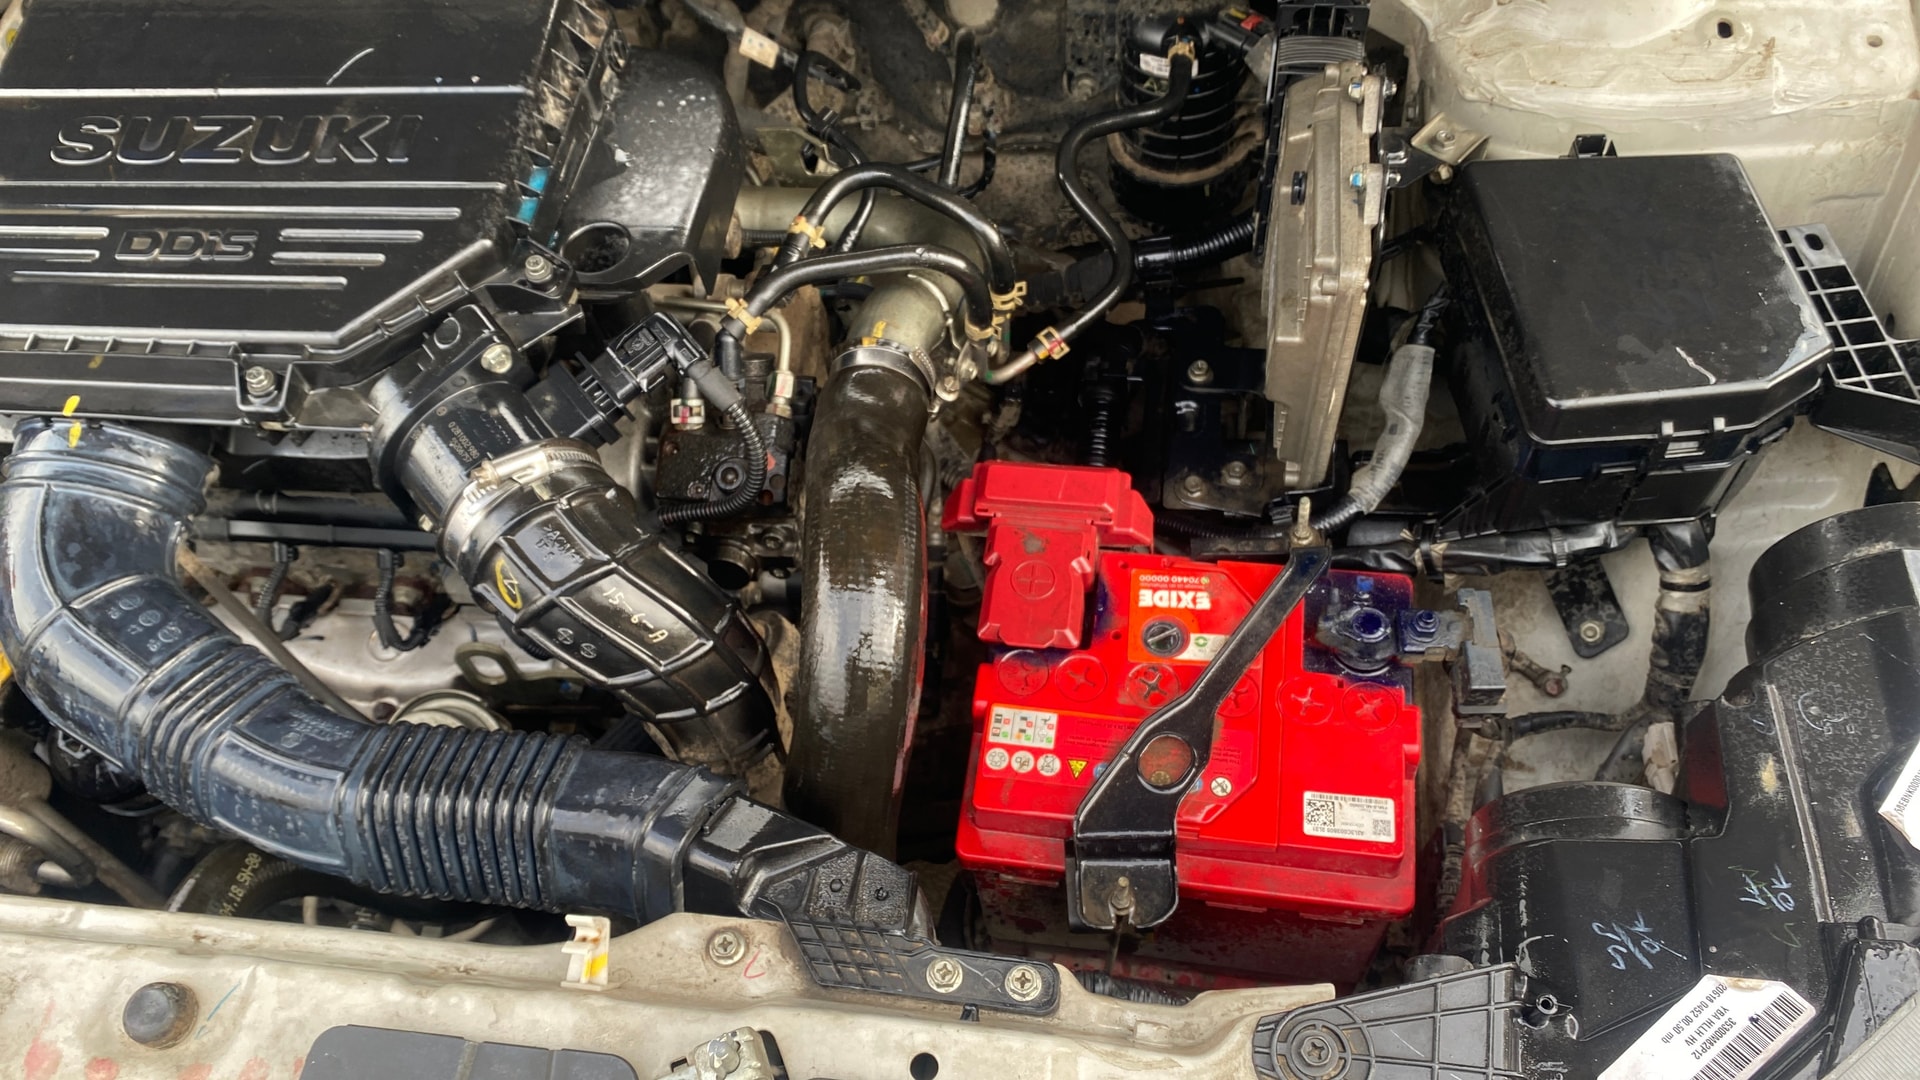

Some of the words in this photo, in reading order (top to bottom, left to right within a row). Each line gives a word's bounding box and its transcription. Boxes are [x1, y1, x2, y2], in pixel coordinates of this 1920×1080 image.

[50, 114, 423, 165] SUZUKI
[1138, 589, 1211, 610] EXIDE
[1689, 1000, 1709, 1018] 0452
[1711, 1006, 1730, 1021] YBA
[1694, 1017, 1716, 1036] HLLH
[1661, 1031, 1674, 1044] mb
[1684, 1034, 1698, 1046] HV
